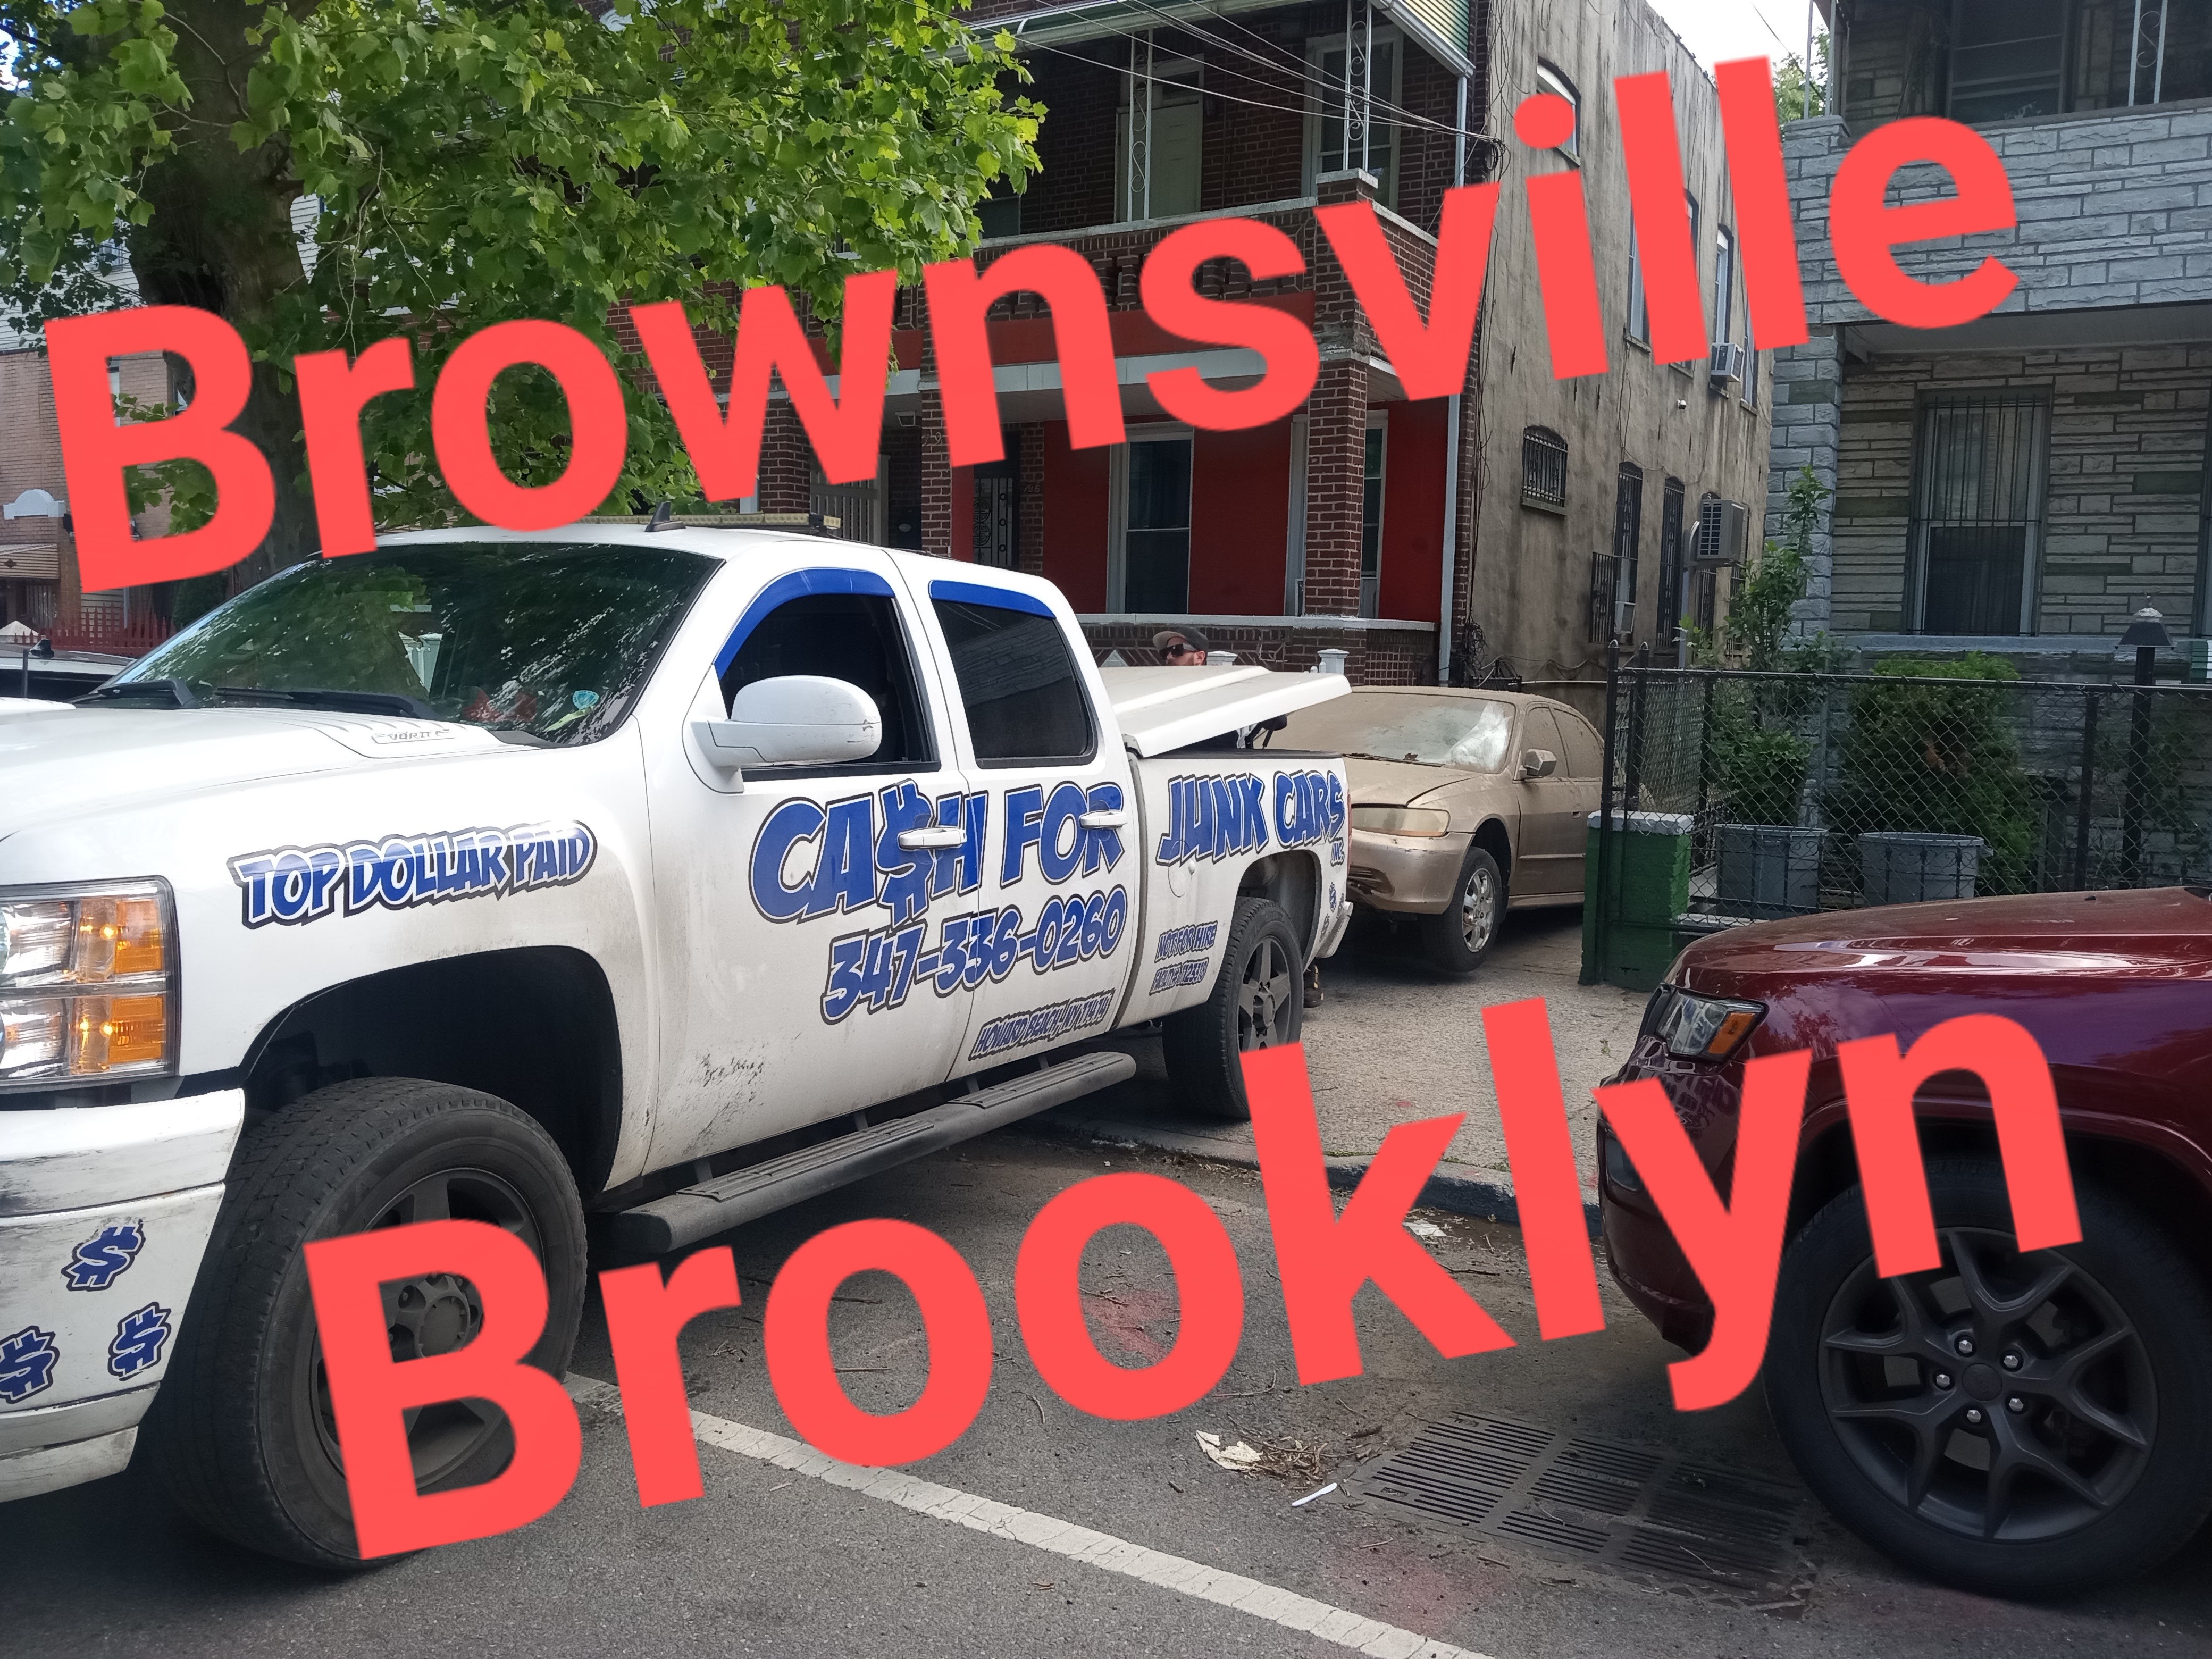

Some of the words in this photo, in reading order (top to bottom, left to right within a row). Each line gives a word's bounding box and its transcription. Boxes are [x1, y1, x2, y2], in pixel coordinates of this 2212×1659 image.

[234, 845, 346, 924] TOP
[346, 831, 510, 911] DOLLAR
[508, 823, 596, 895] PAID
[1001, 781, 1124, 887] FOR
[1156, 773, 1268, 865] JUNK
[1273, 771, 1345, 845] CARS
[1330, 839, 1344, 866] INC.
[823, 886, 1128, 1020] 347-336-0260
[1157, 931, 1178, 959] NOT
[1175, 926, 1195, 956] FOR
[1192, 924, 1217, 950] HIRE
[973, 1015, 1030, 1055] HOWARD
[1062, 1003, 1082, 1032] NY
[1075, 995, 1112, 1028] 11414
